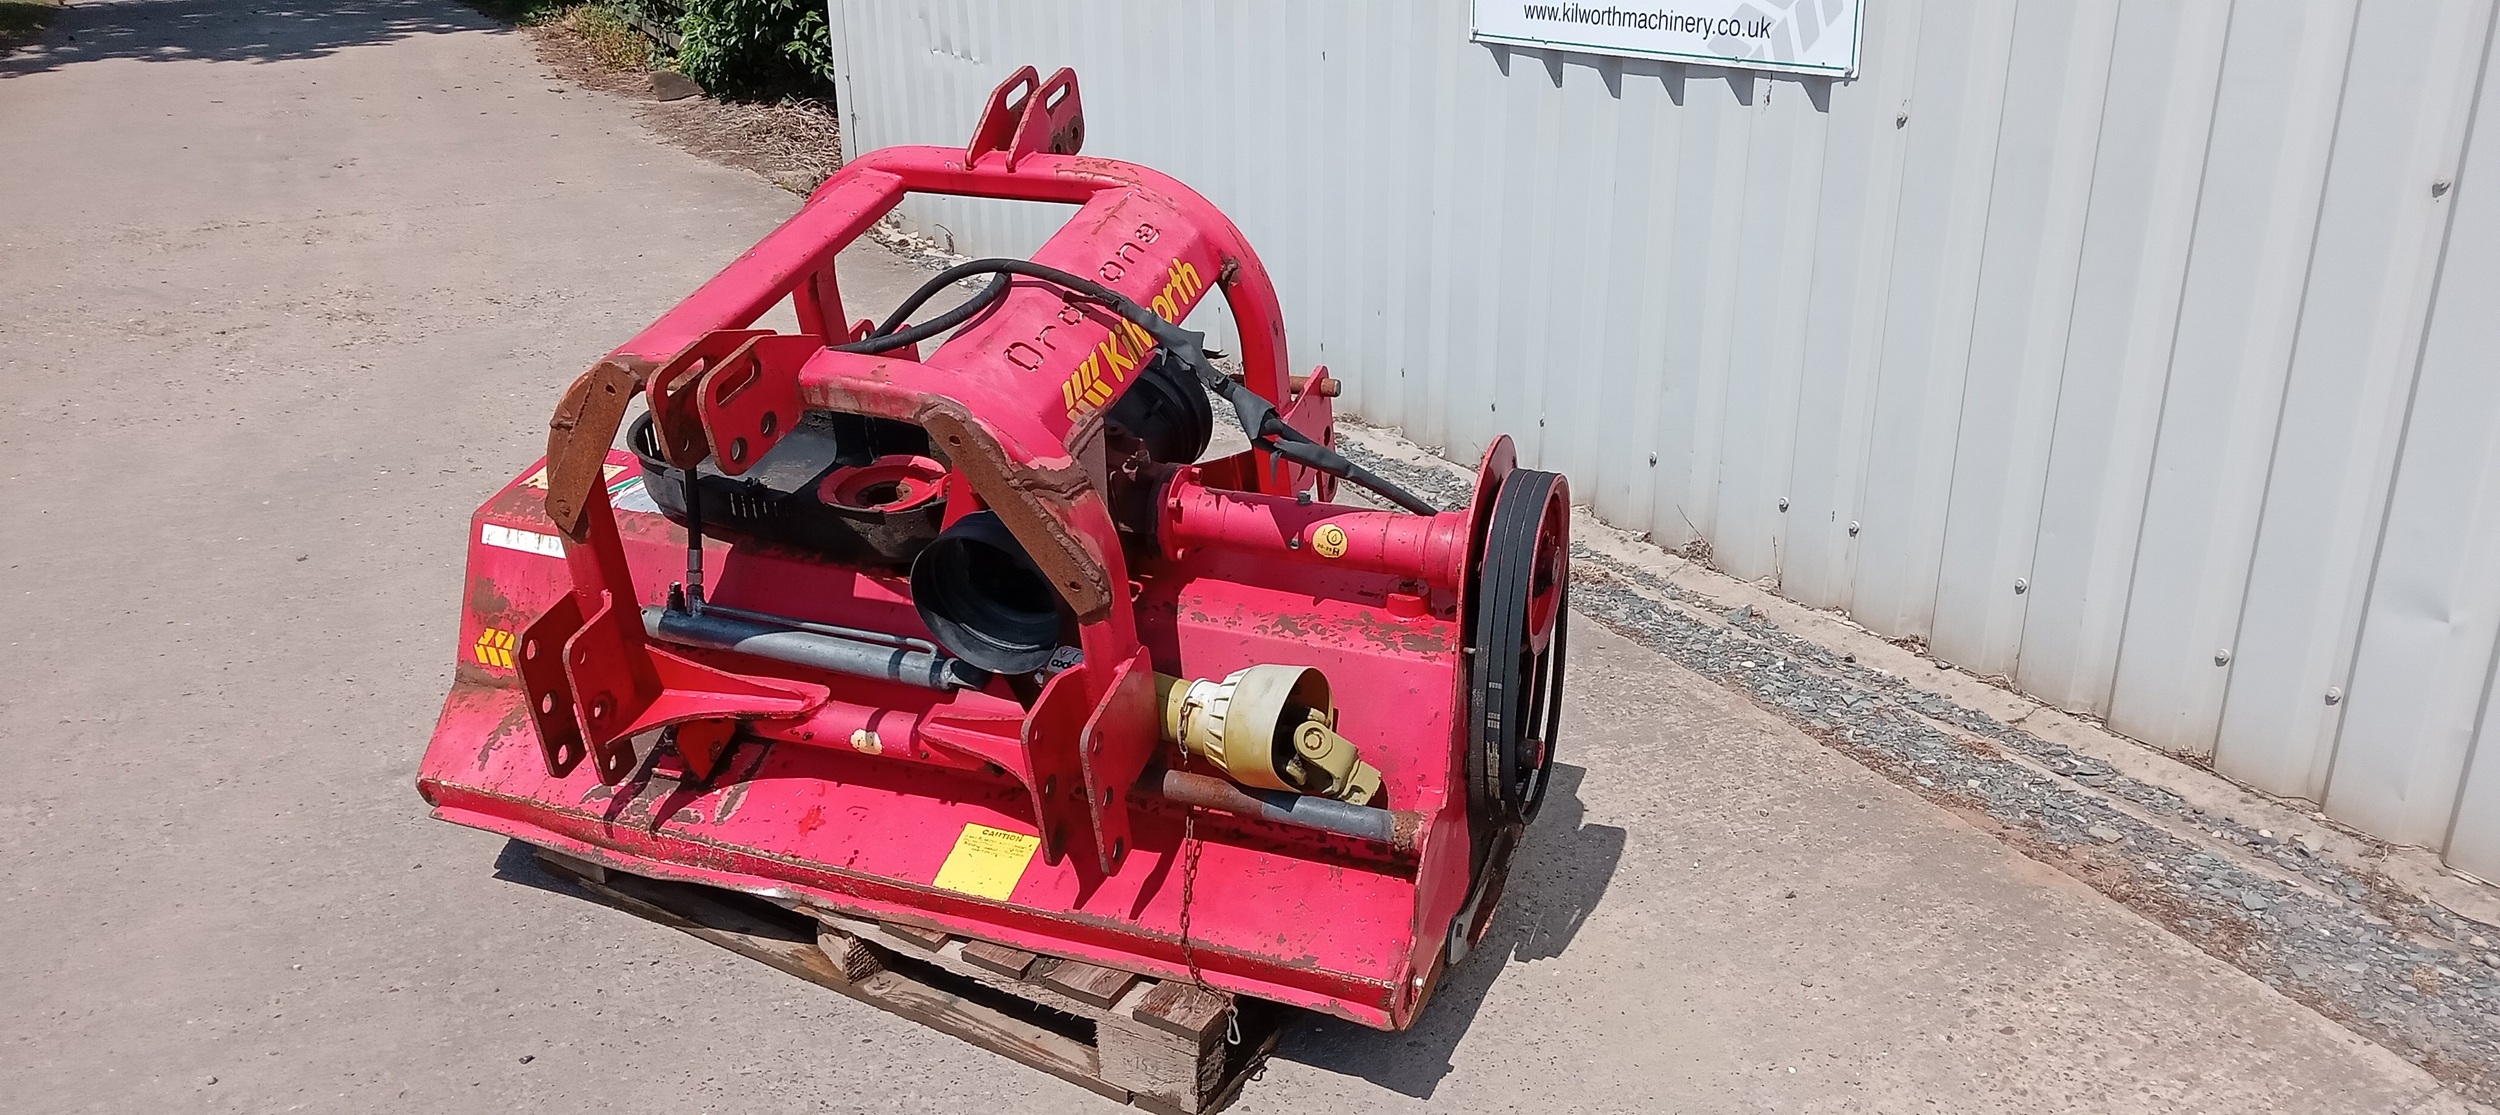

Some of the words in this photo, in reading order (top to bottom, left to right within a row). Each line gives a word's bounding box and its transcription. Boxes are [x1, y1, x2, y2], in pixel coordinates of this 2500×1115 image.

[1523, 2, 1772, 40] www.kilworthmachinery.co.uk
[1003, 222, 1162, 372] Draone
[982, 829, 1023, 842] CAUTION
